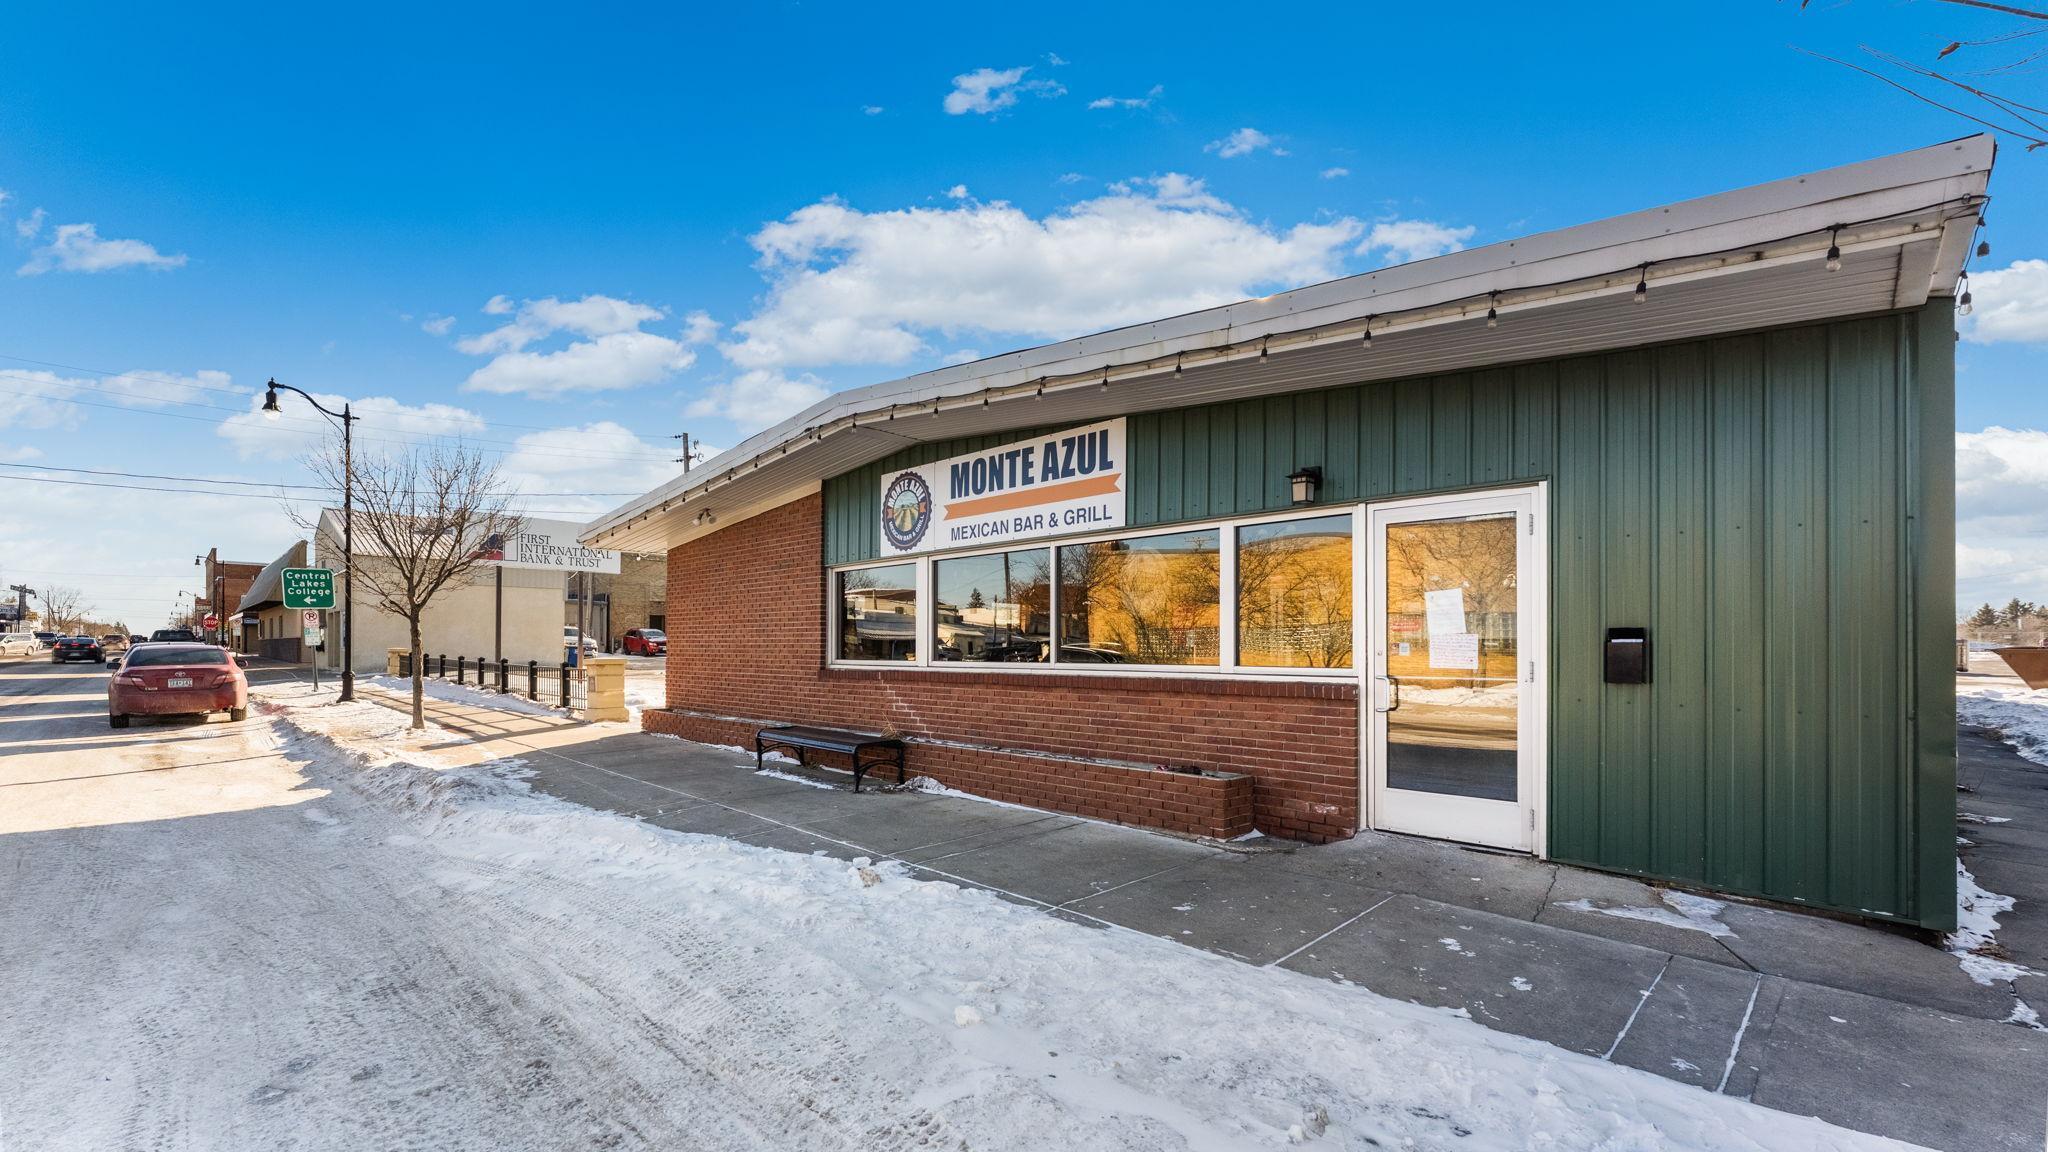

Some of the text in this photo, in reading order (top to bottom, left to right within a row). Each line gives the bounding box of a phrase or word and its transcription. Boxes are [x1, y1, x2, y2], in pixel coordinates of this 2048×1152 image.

[950, 429, 1114, 500] MONTE AZUL
[887, 479, 926, 508] MONTE AZUL
[888, 520, 904, 541] MEXICAN
[903, 533, 913, 541] BAR
[915, 514, 925, 533] GRILL
[951, 504, 1113, 541] MEXICAN BAR & GRILL
[520, 533, 551, 545] FIRST
[520, 543, 612, 560] INTERNATIONAL
[520, 553, 602, 568] BANK & TRUST
[286, 572, 330, 580] Central
[287, 587, 331, 596] College
